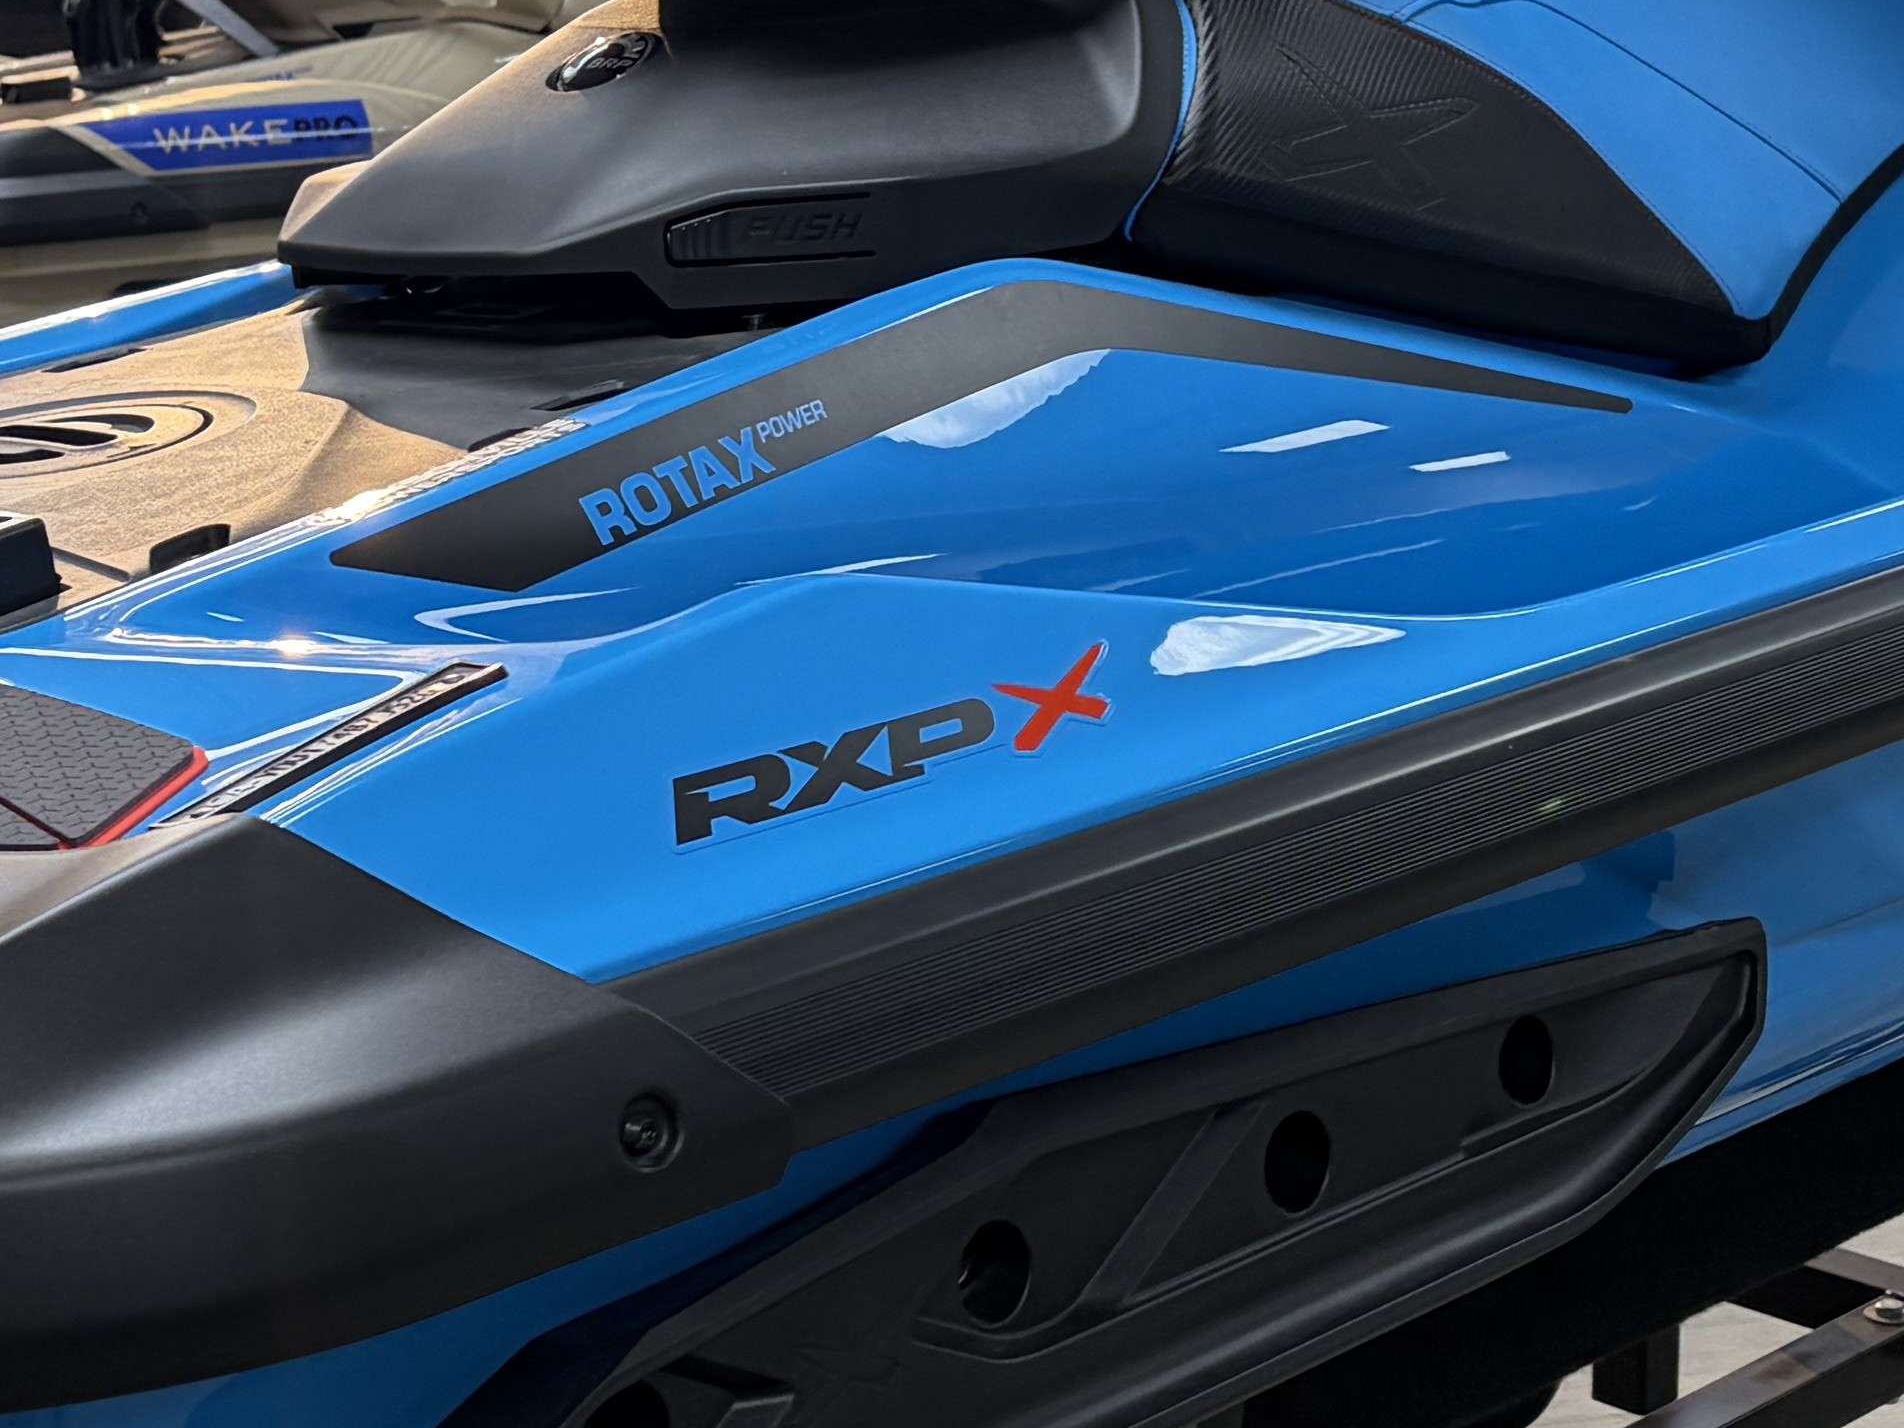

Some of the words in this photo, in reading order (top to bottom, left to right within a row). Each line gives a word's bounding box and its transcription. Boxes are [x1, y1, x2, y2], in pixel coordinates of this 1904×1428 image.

[586, 57, 634, 69] BRP
[152, 118, 293, 154] WAKE
[293, 114, 361, 143] PRO
[746, 211, 862, 243] PUSH
[578, 427, 777, 546] ROTAX
[756, 399, 828, 444] POWER
